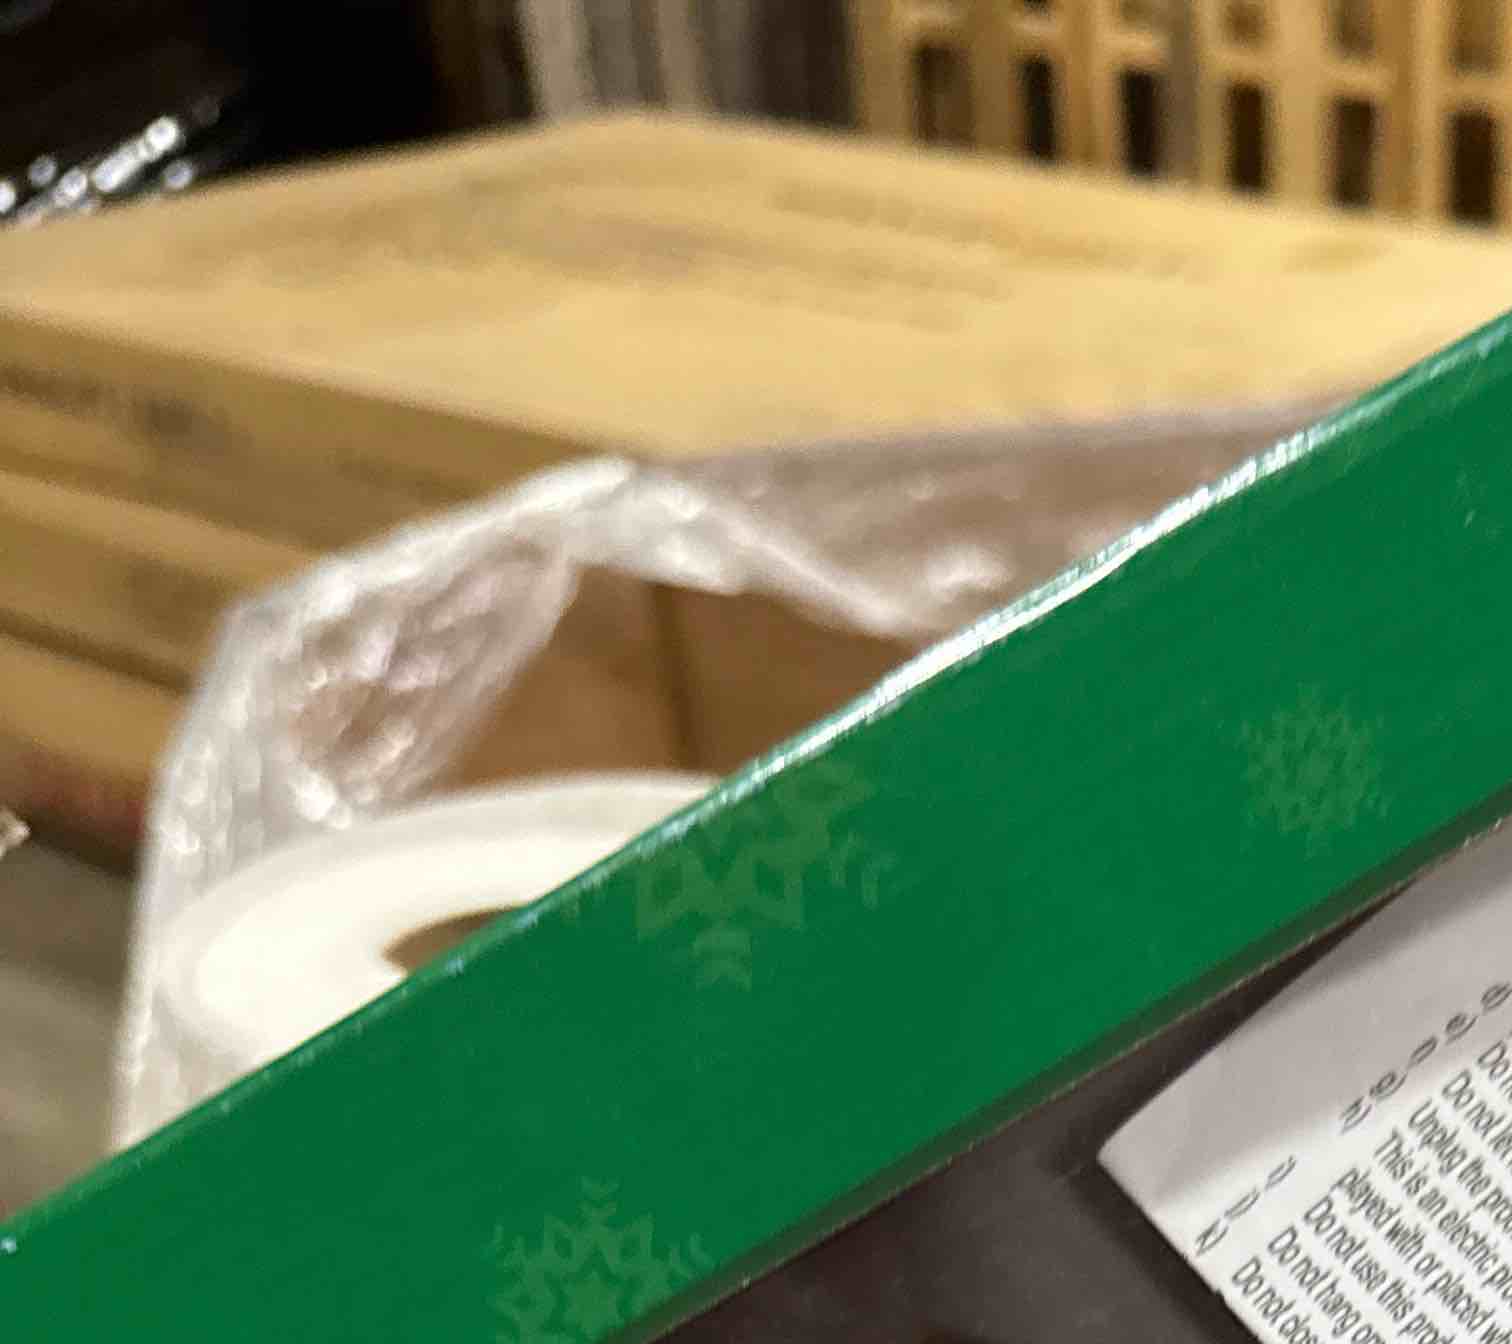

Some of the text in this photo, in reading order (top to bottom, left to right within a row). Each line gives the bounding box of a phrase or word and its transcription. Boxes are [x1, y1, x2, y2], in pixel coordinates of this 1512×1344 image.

[1403, 1097, 1472, 1177] Unplug
[1455, 1155, 1495, 1199] the
[1265, 1224, 1304, 1267] Do
[1287, 1252, 1332, 1296] not
[1301, 1193, 1340, 1237] Do
[1324, 1223, 1367, 1265] not
[1348, 1251, 1389, 1293] use
[1375, 1277, 1418, 1323] this
[1229, 1254, 1269, 1298] Do
[1251, 1283, 1297, 1326] not
[1309, 1276, 1365, 1339] hang
